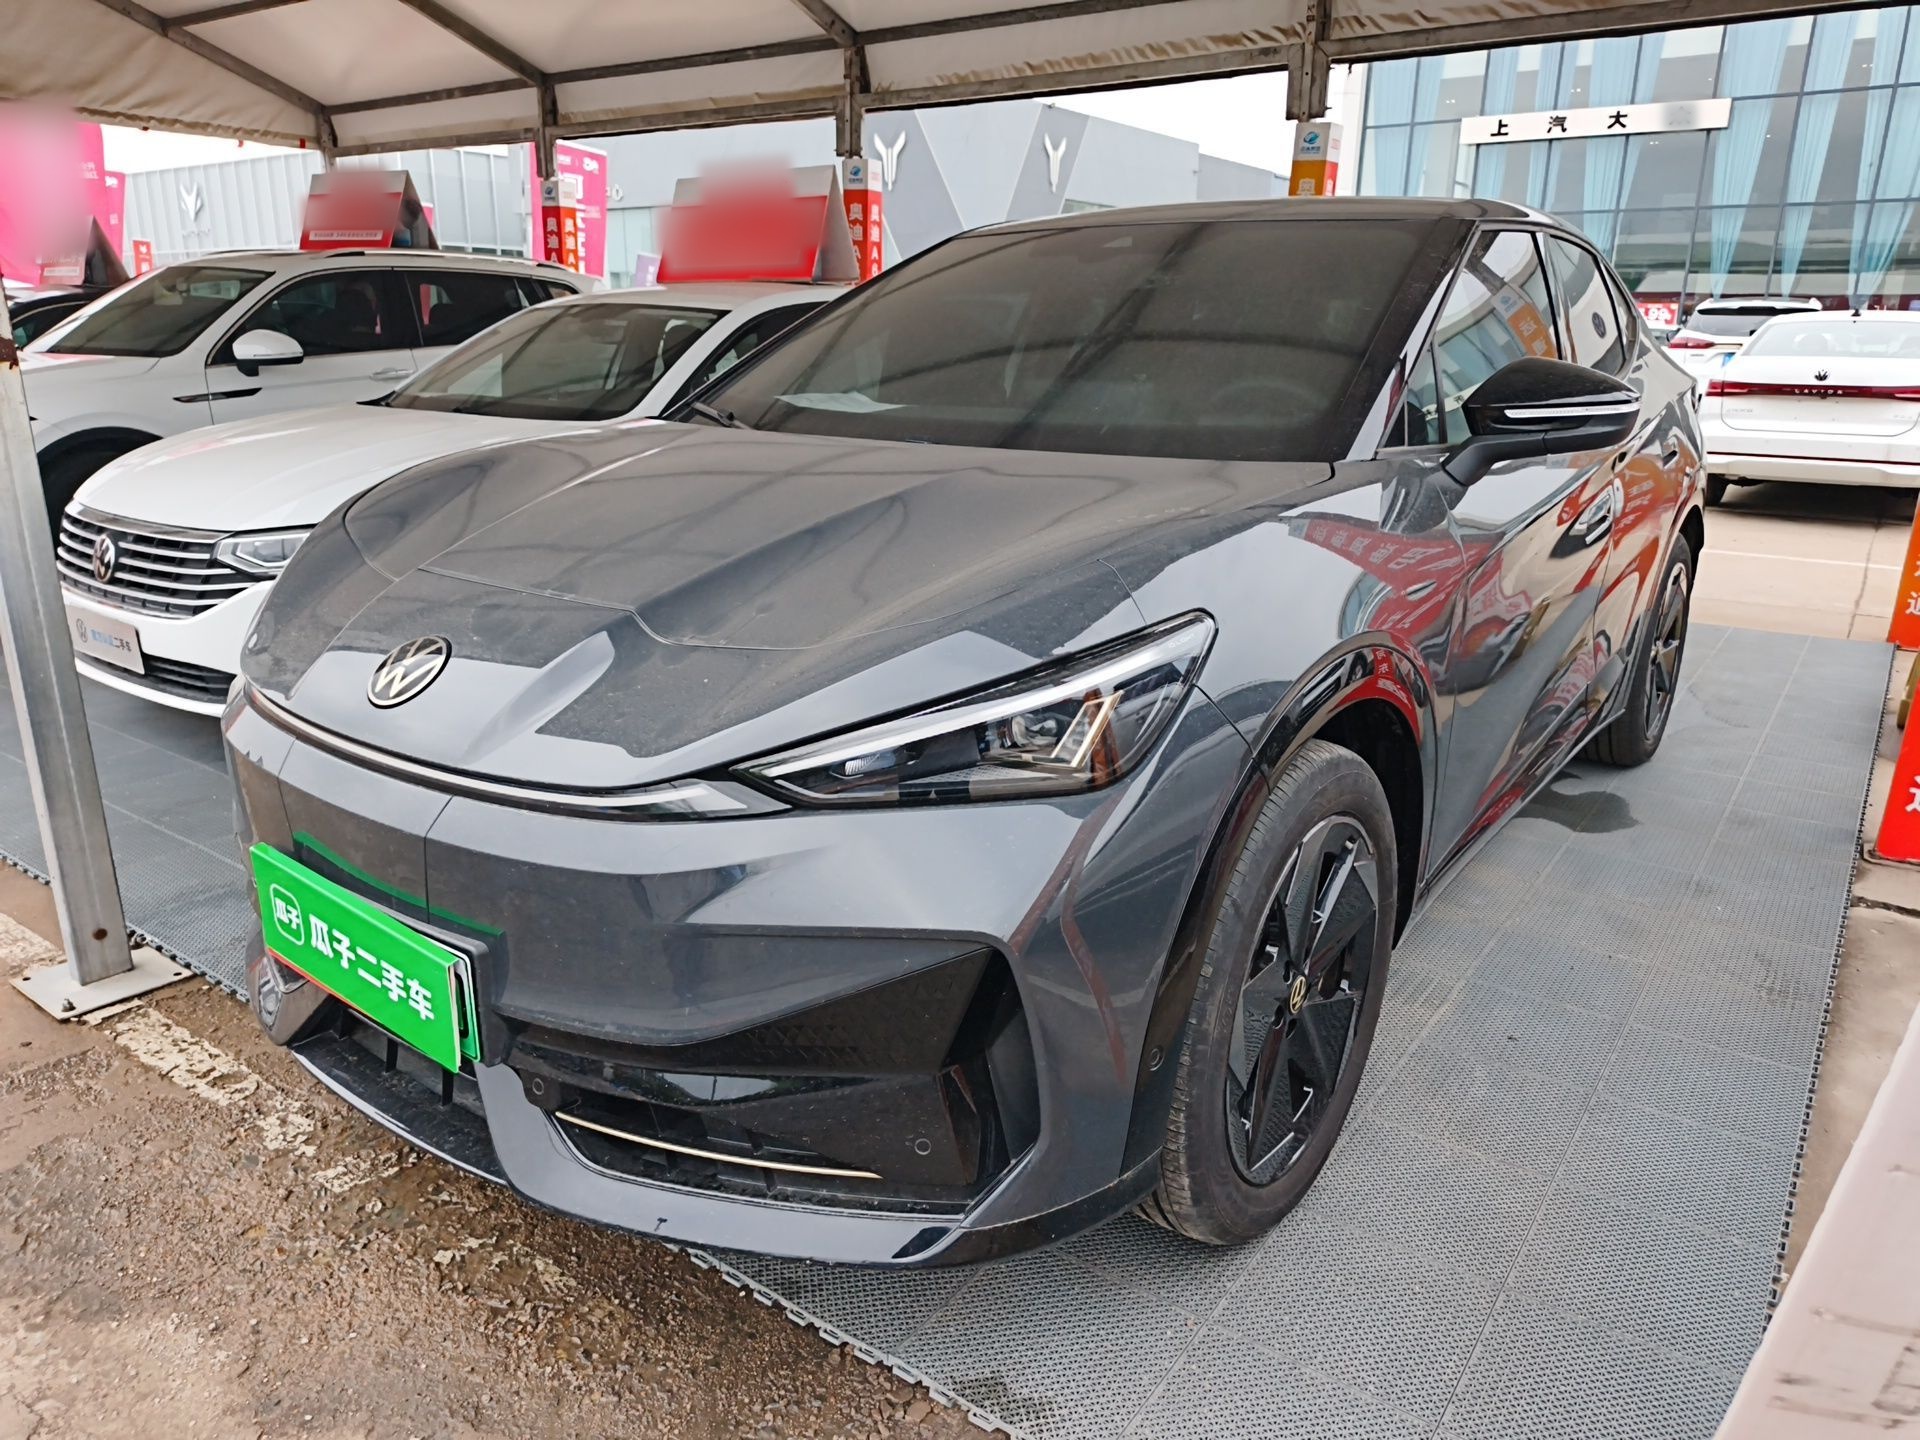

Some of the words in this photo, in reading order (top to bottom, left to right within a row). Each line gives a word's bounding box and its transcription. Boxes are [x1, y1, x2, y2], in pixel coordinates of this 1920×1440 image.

[274, 897, 300, 930] 瓜子
[308, 913, 435, 1021] 瓜子二手车
